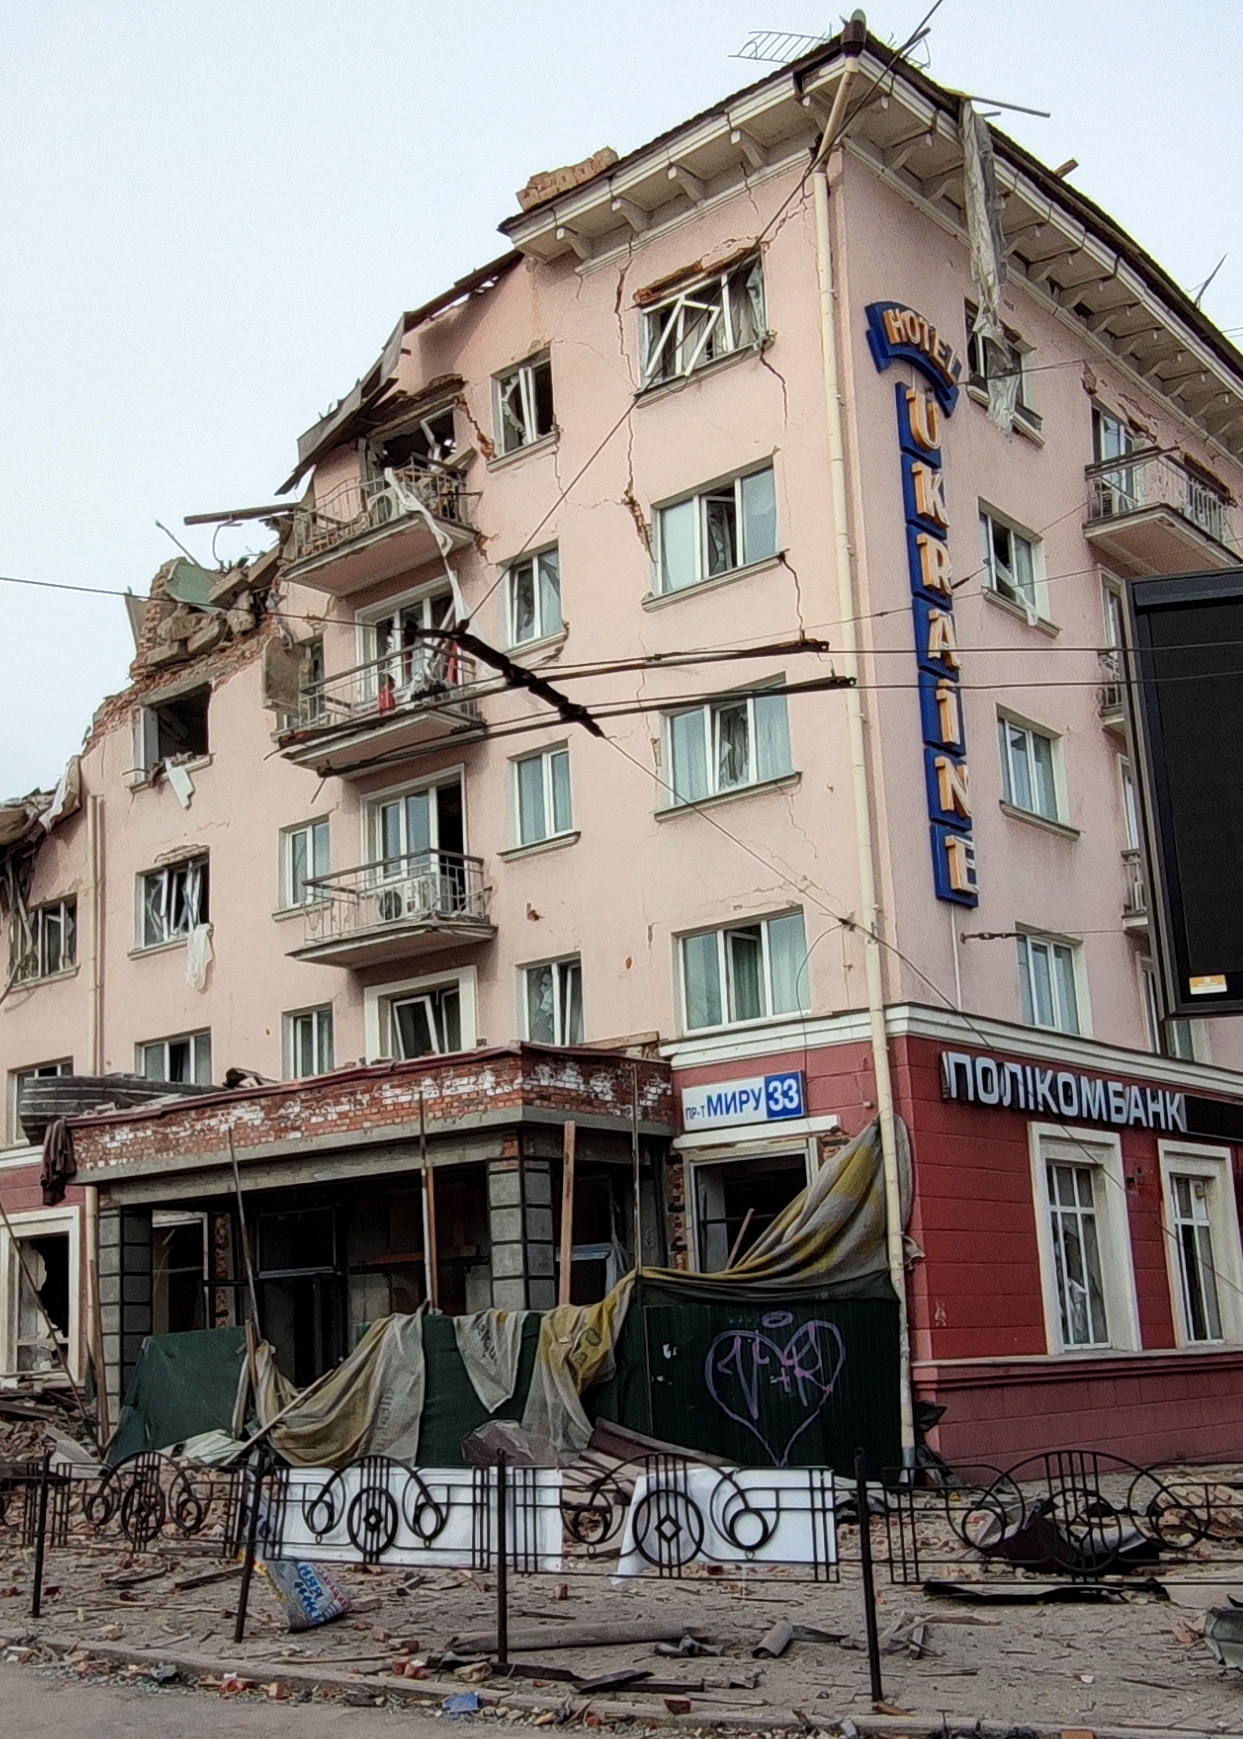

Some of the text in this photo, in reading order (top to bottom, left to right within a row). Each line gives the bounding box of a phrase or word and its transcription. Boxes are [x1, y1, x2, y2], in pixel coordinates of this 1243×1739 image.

[883, 308, 957, 386] HOTEL
[706, 1086, 762, 1117] МИРУ
[768, 1078, 799, 1111] 33
[944, 1051, 1186, 1132] ПОЛІКОМБАНК
